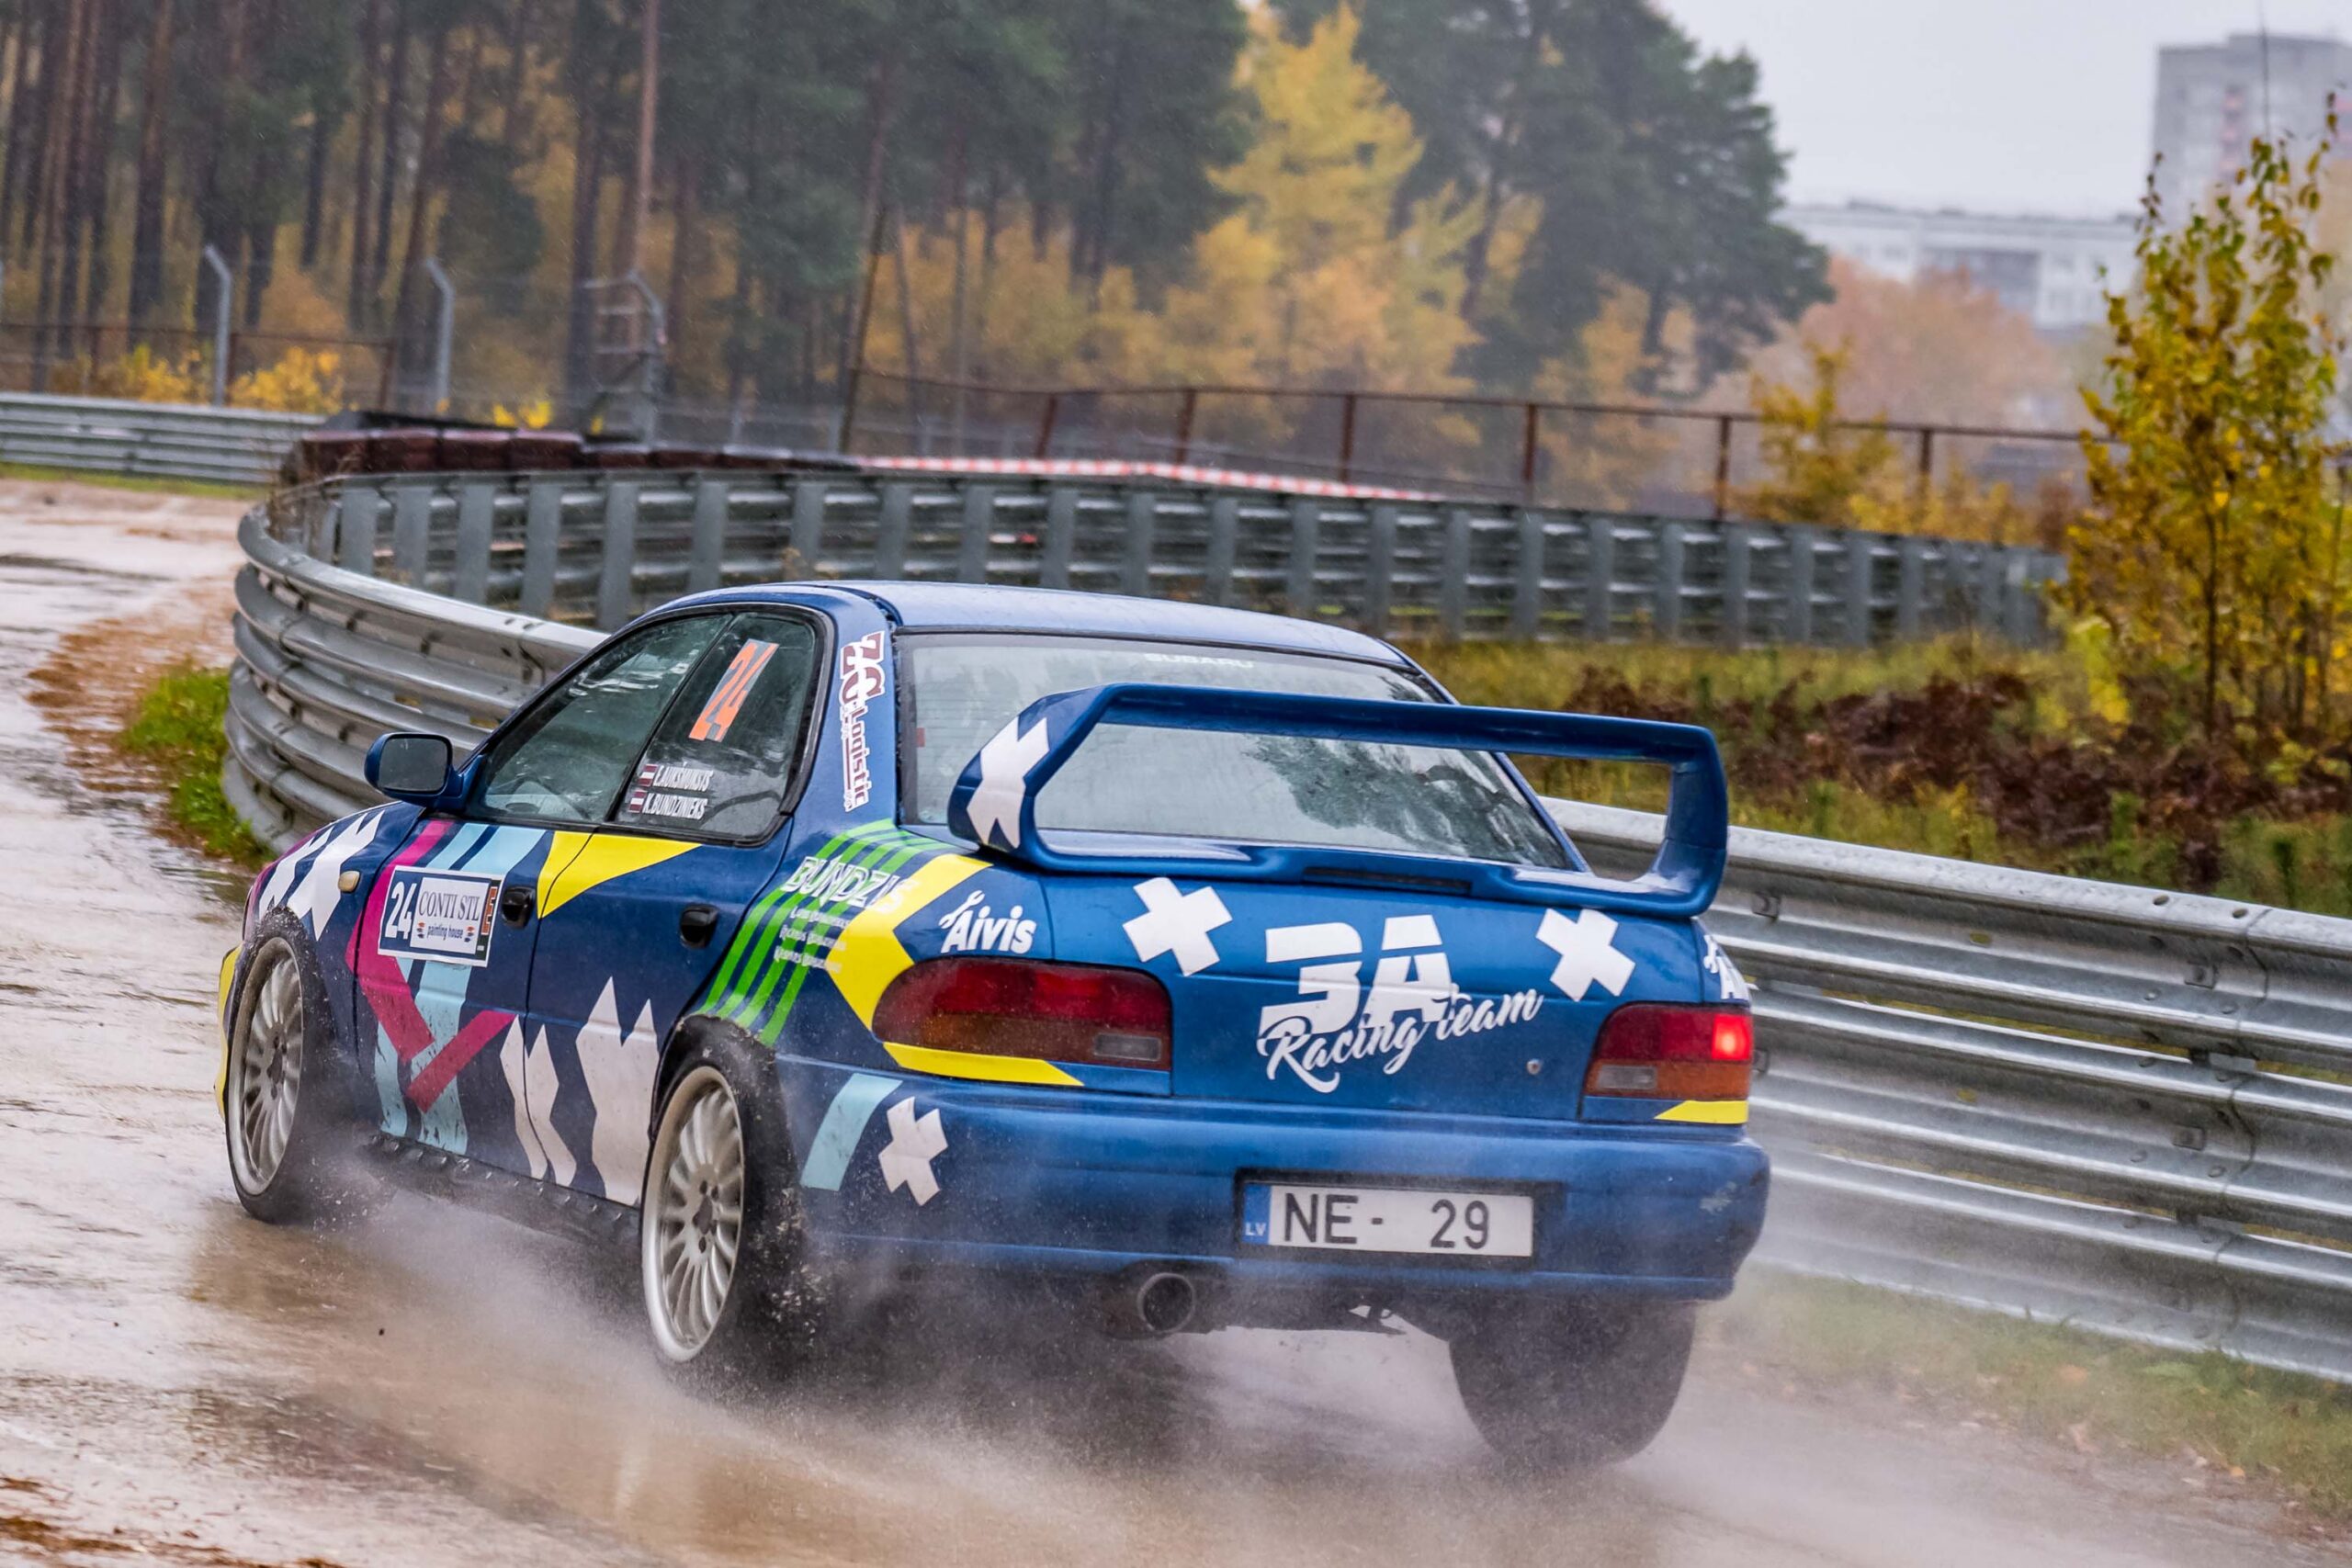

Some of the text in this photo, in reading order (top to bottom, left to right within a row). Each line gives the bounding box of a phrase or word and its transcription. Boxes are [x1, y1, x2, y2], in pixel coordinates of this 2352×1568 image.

[1144, 653, 1254, 668] SUBARU
[689, 639, 779, 741] 24
[850, 706, 870, 807] Logistic
[385, 881, 417, 940] 24
[419, 891, 480, 921] CONTI STL
[1256, 982, 1544, 1093] Racing team
[1245, 1223, 1266, 1237] LV
[1430, 1198, 1489, 1250] 29
